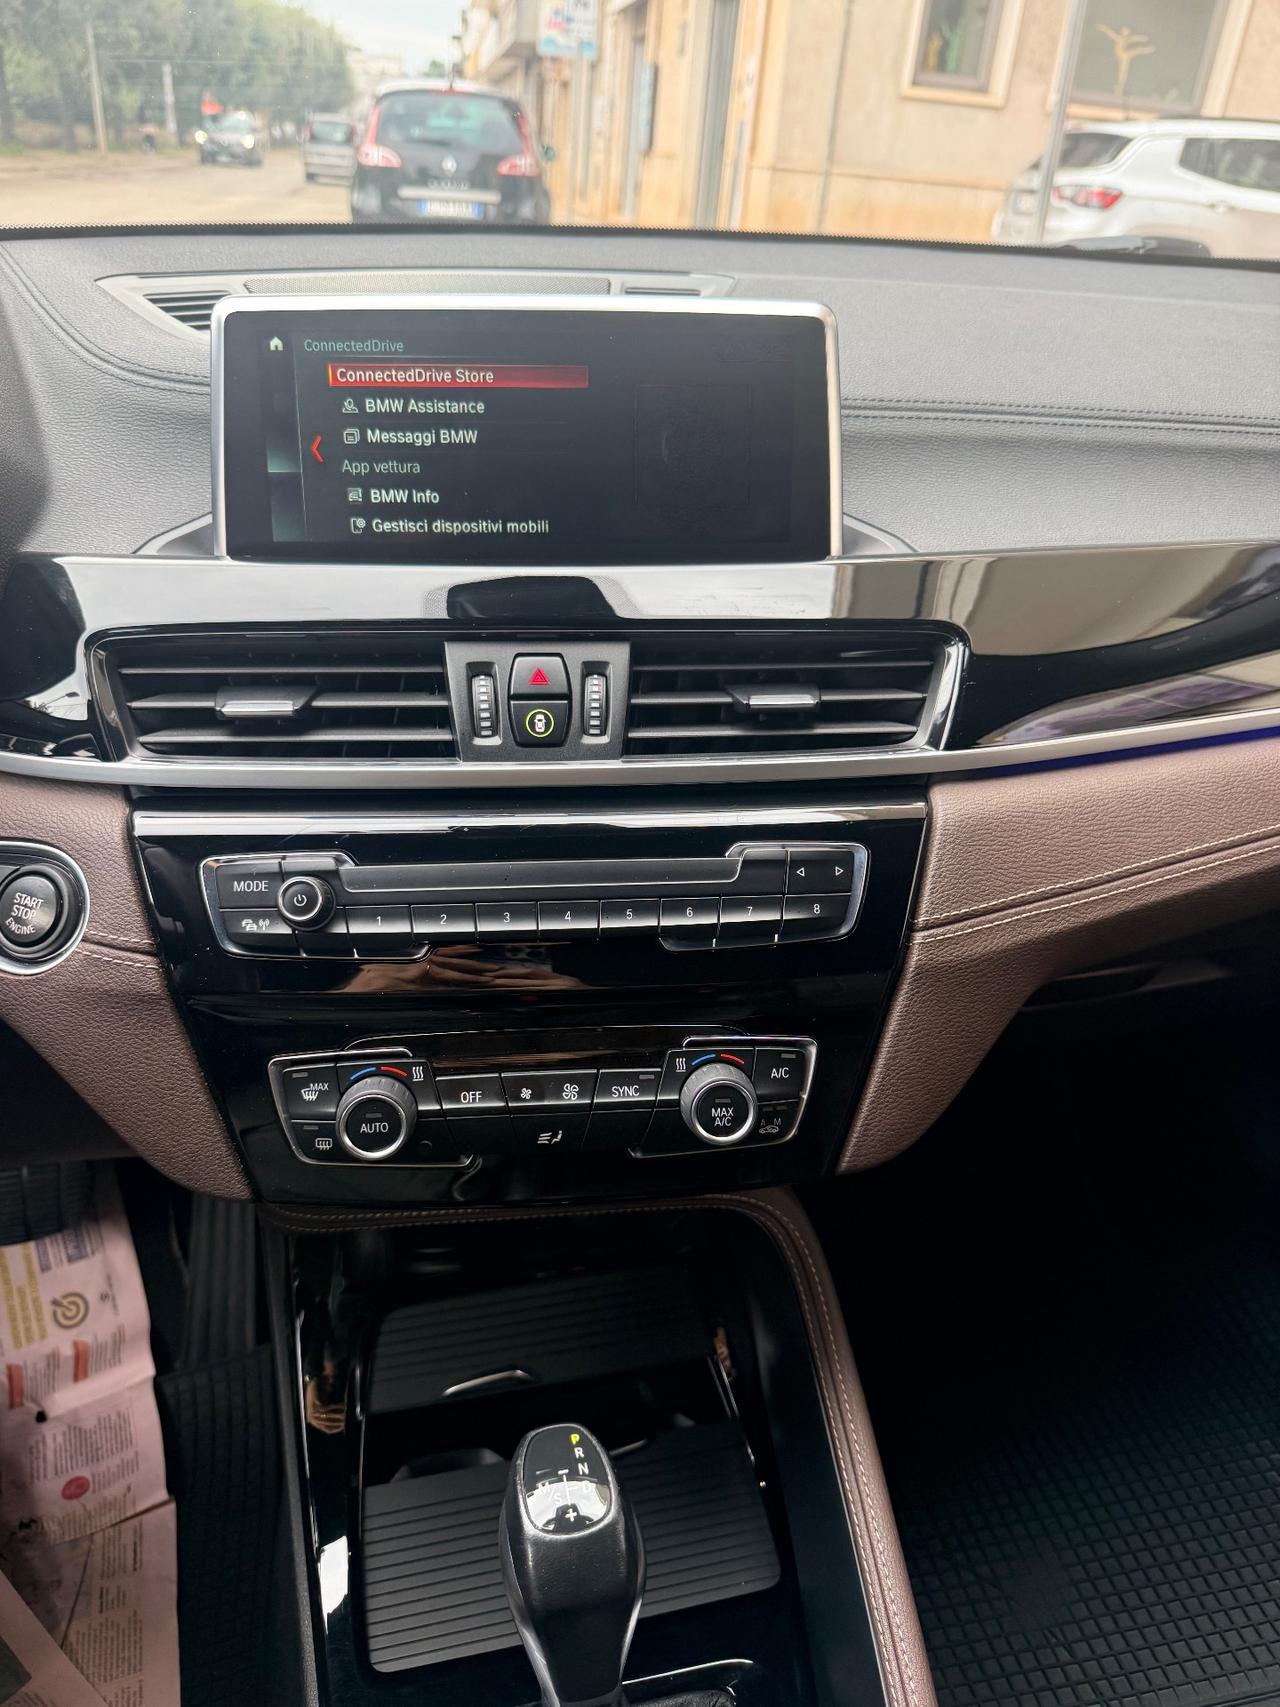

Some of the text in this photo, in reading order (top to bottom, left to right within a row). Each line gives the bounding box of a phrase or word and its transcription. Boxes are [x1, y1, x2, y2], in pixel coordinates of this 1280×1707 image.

[303, 339, 404, 352] ConnectedDrive
[336, 368, 494, 384] ConnectedDrive Store
[365, 399, 485, 414] BMW Assistance
[367, 429, 478, 446] Messaggi BMW
[341, 460, 420, 475] App vettura
[370, 490, 439, 504] BMW Info
[372, 518, 549, 536] Gestisci dispositivi mobili
[233, 880, 269, 892] MODE
[14, 892, 44, 910] START
[11, 905, 37, 920] STOP
[626, 909, 633, 920] 5
[686, 907, 693, 918] 6
[746, 906, 753, 917] 7
[813, 903, 821, 915] 8
[376, 916, 381, 926] 1
[440, 914, 447, 925] 2
[503, 912, 510, 923] 3
[564, 911, 572, 921] 4
[5, 917, 36, 935] ENGINE
[770, 1067, 790, 1079] A/C
[309, 1083, 329, 1091] MAX
[611, 1086, 640, 1098] SYNC
[460, 1091, 482, 1103] OFF
[711, 1107, 734, 1117] MAX
[714, 1117, 732, 1127] A/C
[773, 1117, 782, 1126] M
[360, 1122, 389, 1134] AUTO
[570, 1433, 580, 1445] P
[574, 1447, 585, 1459] R
[577, 1462, 589, 1475] N
